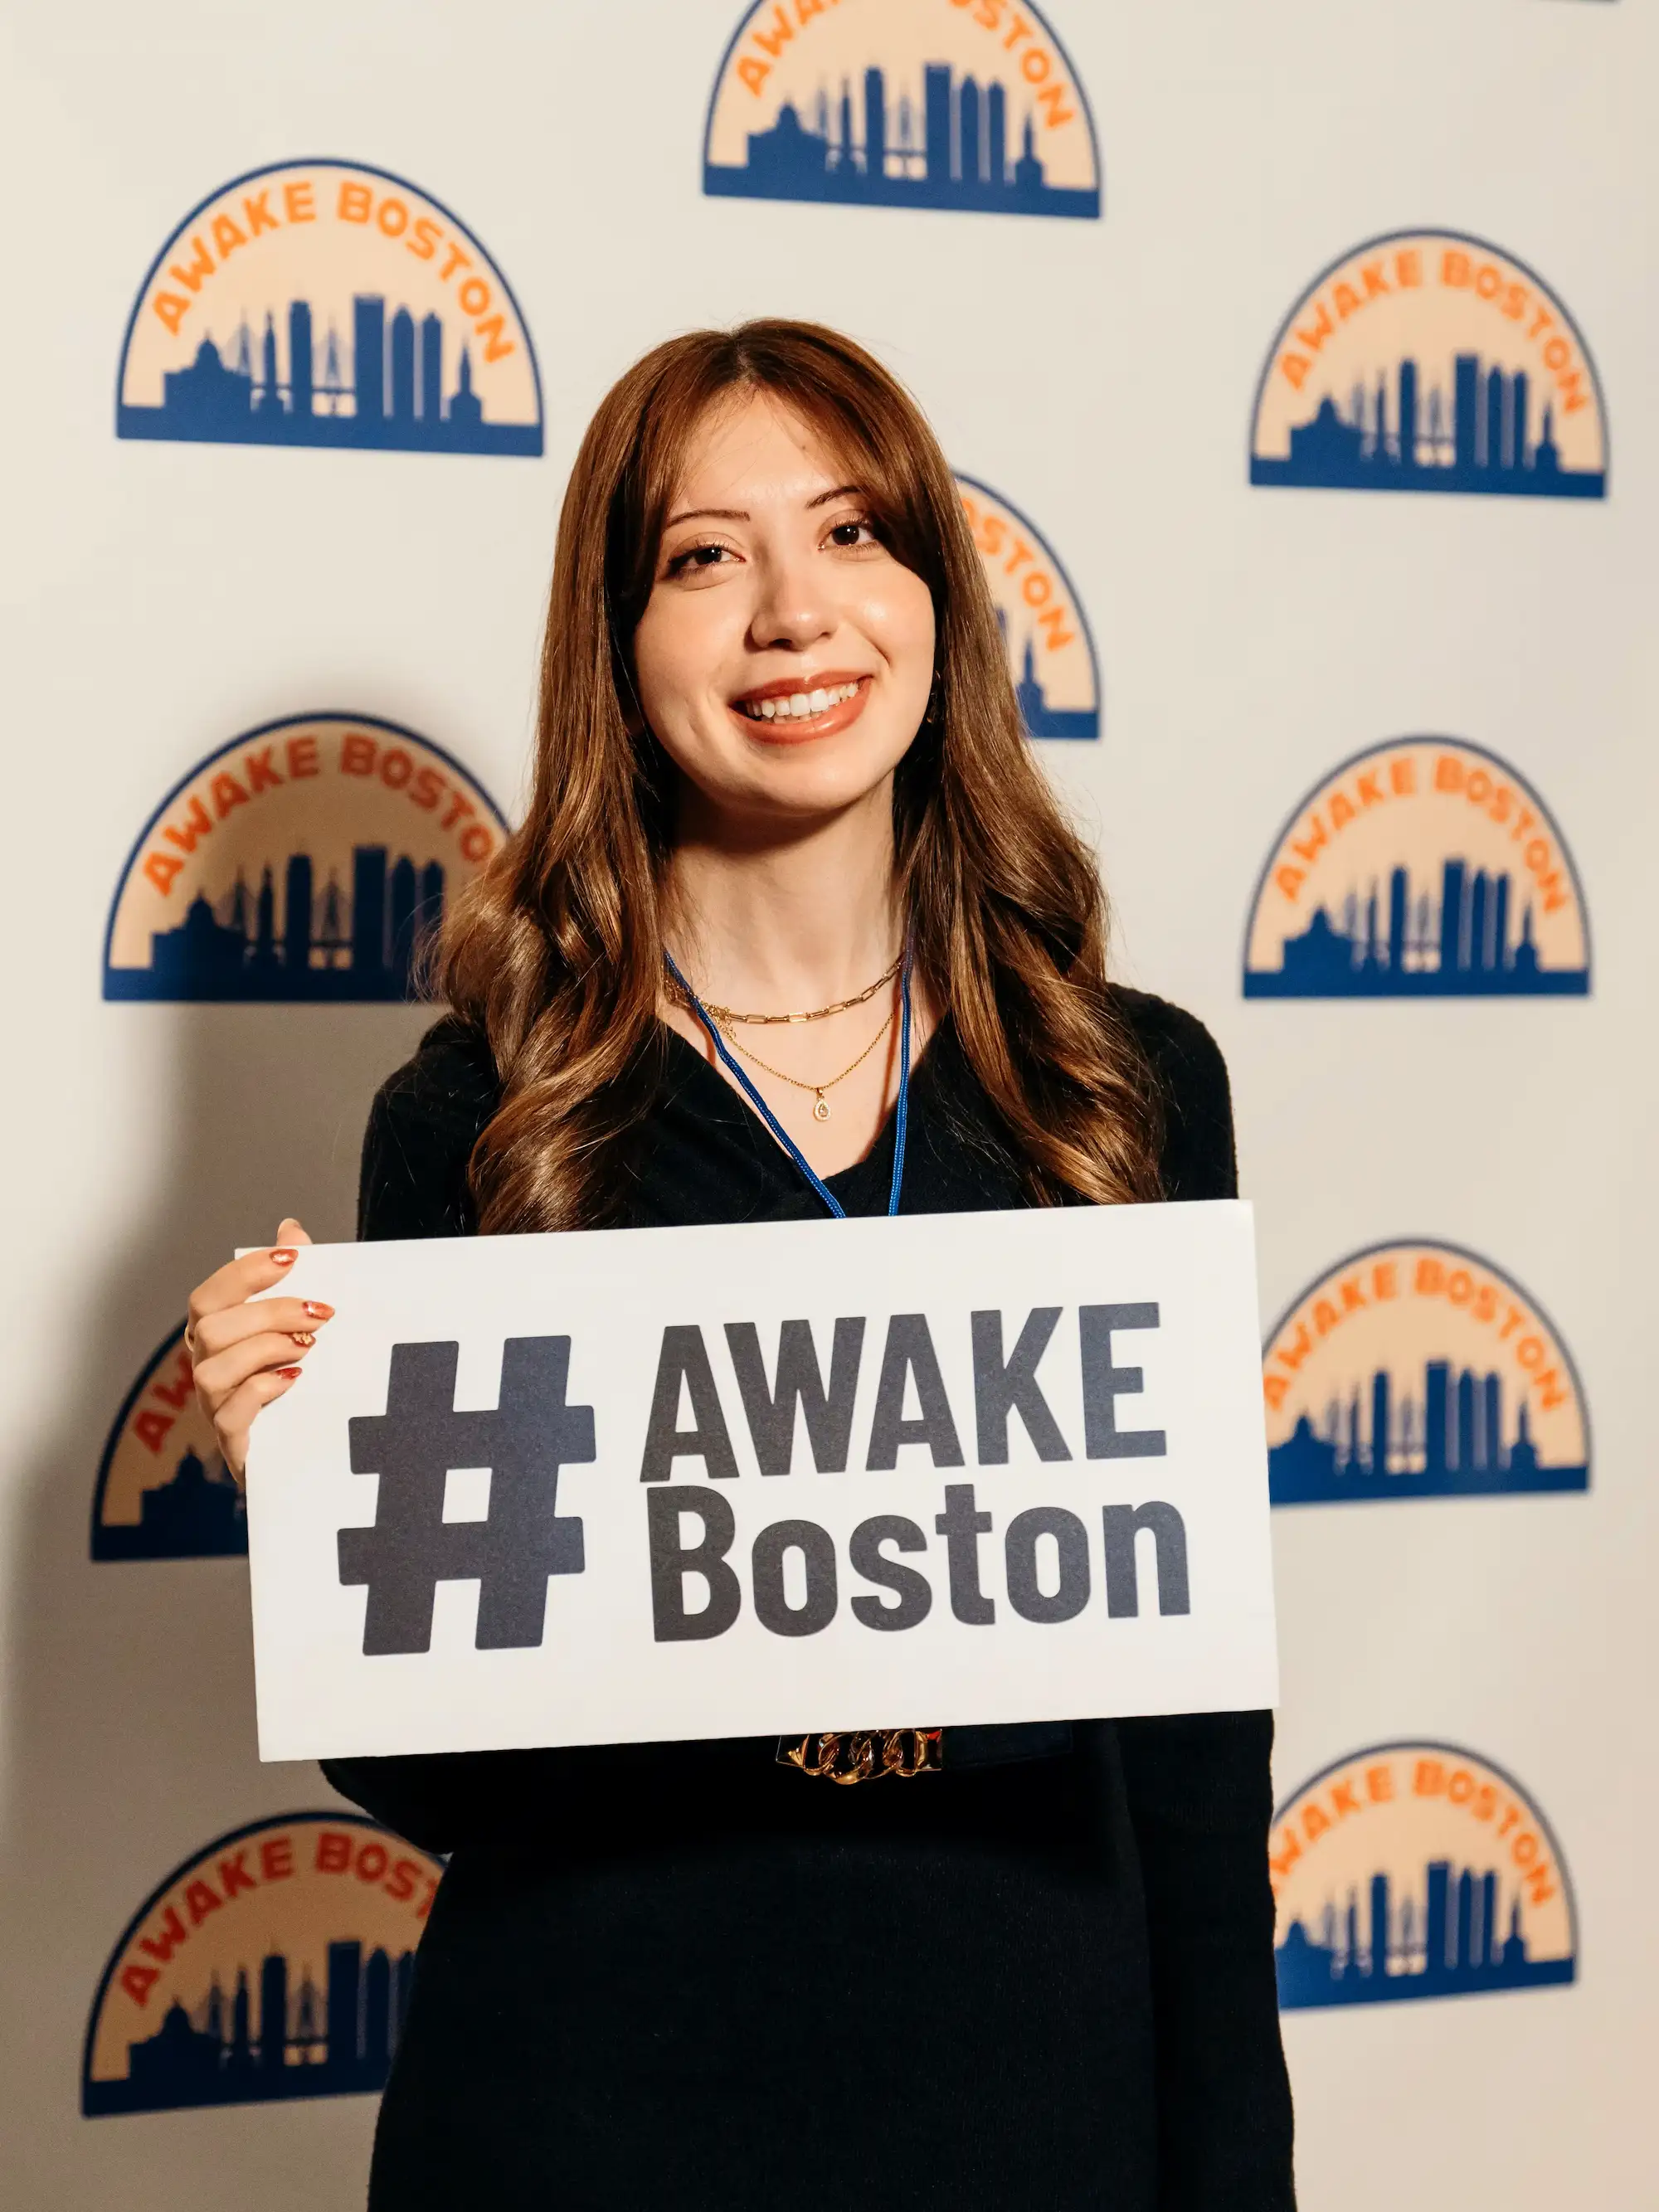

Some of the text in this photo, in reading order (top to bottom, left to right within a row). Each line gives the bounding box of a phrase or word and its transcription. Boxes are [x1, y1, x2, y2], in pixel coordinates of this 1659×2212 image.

[949, 0, 1075, 131] STON
[152, 180, 516, 365] AWAKE BOSTON
[1279, 249, 1588, 415] AWAKE BOSTON
[960, 498, 1075, 653] STON
[142, 733, 494, 898] AWAKE BOSTO
[1273, 755, 1568, 915] AWAKE BOSTON
[640, 1301, 1168, 1483] AWAKE
[1412, 1257, 1568, 1413] BOSTON
[646, 1484, 1191, 1643] Boston
[1268, 1758, 1556, 1908] WAKE BOSTON
[120, 1834, 294, 2008] AWAKE
